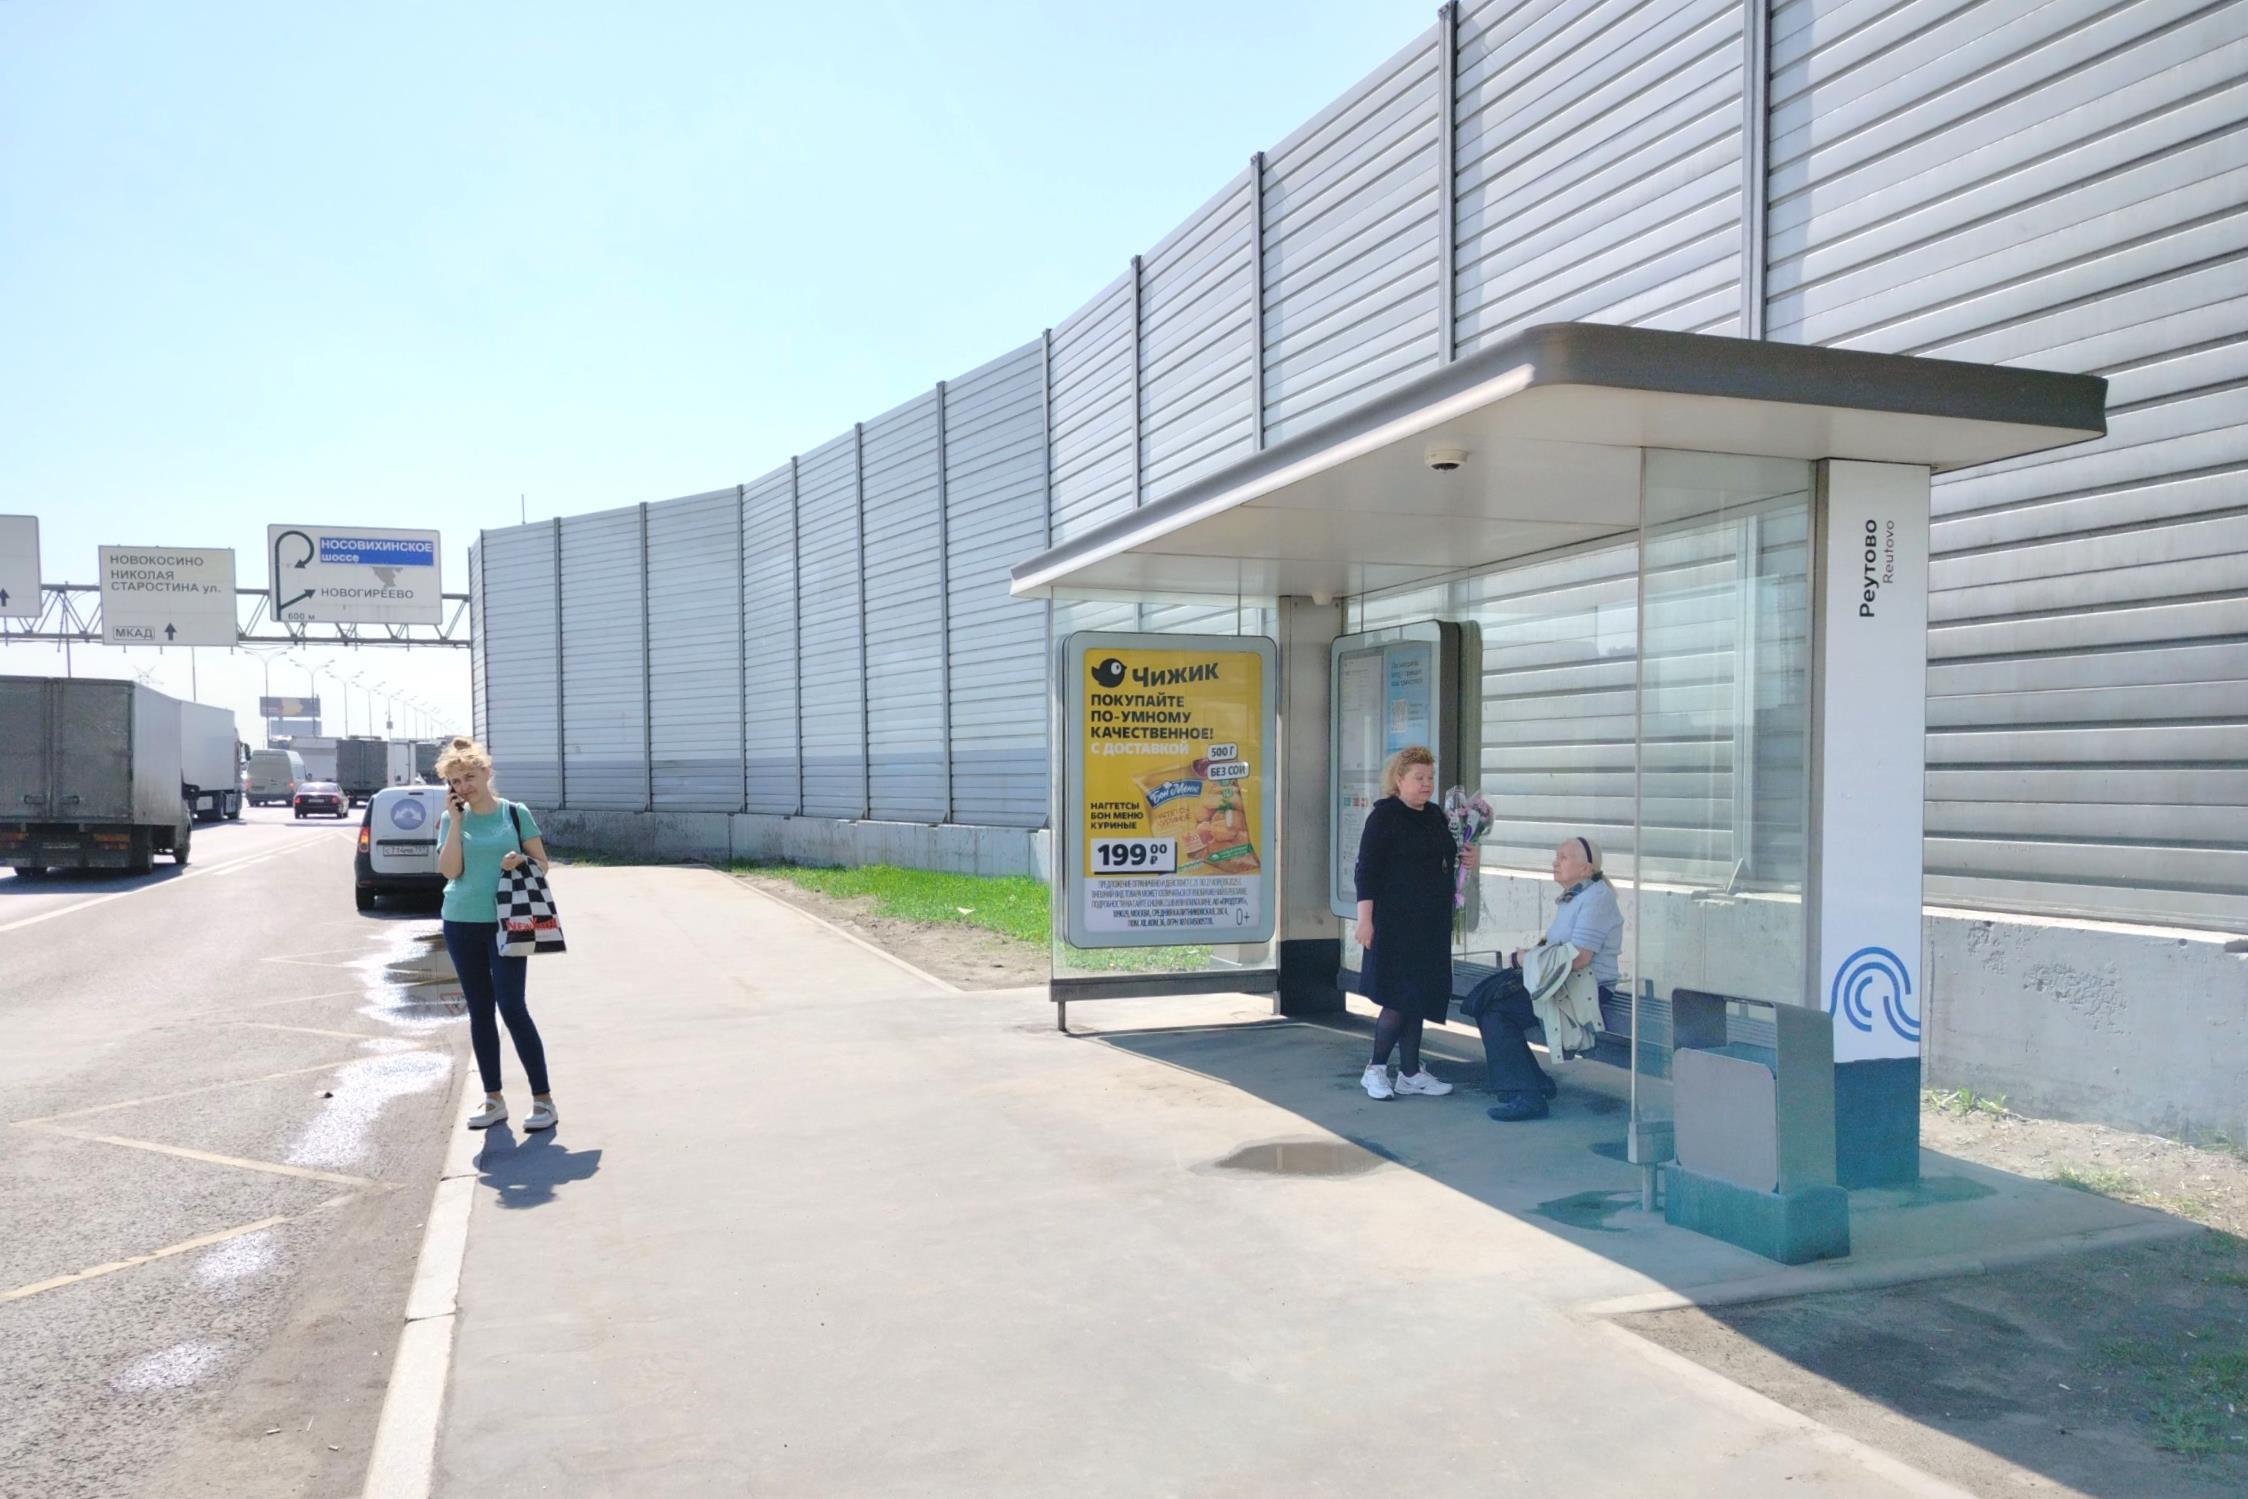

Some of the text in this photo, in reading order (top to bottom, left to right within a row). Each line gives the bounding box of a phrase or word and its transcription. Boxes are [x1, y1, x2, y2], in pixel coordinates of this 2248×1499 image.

[320, 539, 433, 552] НОСОВИХИНСКОЕ
[1883, 520, 1895, 584] Reutovo
[110, 554, 204, 567] НОВОКОСИНО
[321, 554, 360, 562] шоссе
[1859, 519, 1879, 617] Реутово
[111, 569, 175, 581] НИКОЛАЯ
[111, 581, 221, 594] СТАРОСТИНА ул.
[321, 588, 414, 599] НОВОГИРЕЕВО
[288, 612, 305, 620] 600
[115, 628, 153, 640] МКАД
[1091, 692, 1185, 708] ПОКУПАЙТЕ
[1091, 711, 1192, 724] ПО-УМНОМУ
[1091, 727, 1214, 740] КАЧЕСТВЕННОЕ!
[1091, 740, 1190, 756] С ДОСТАВКОЙ
[1211, 746, 1229, 757] 500
[1210, 766, 1227, 777] БЕЗ
[1091, 802, 1140, 810] НАГГЕТСЫ
[1091, 812, 1144, 820] БОН МЕНЮ
[1091, 821, 1137, 830] КУРИНЫЕ
[1098, 843, 1147, 866] 199
[1235, 907, 1251, 927] 0+
